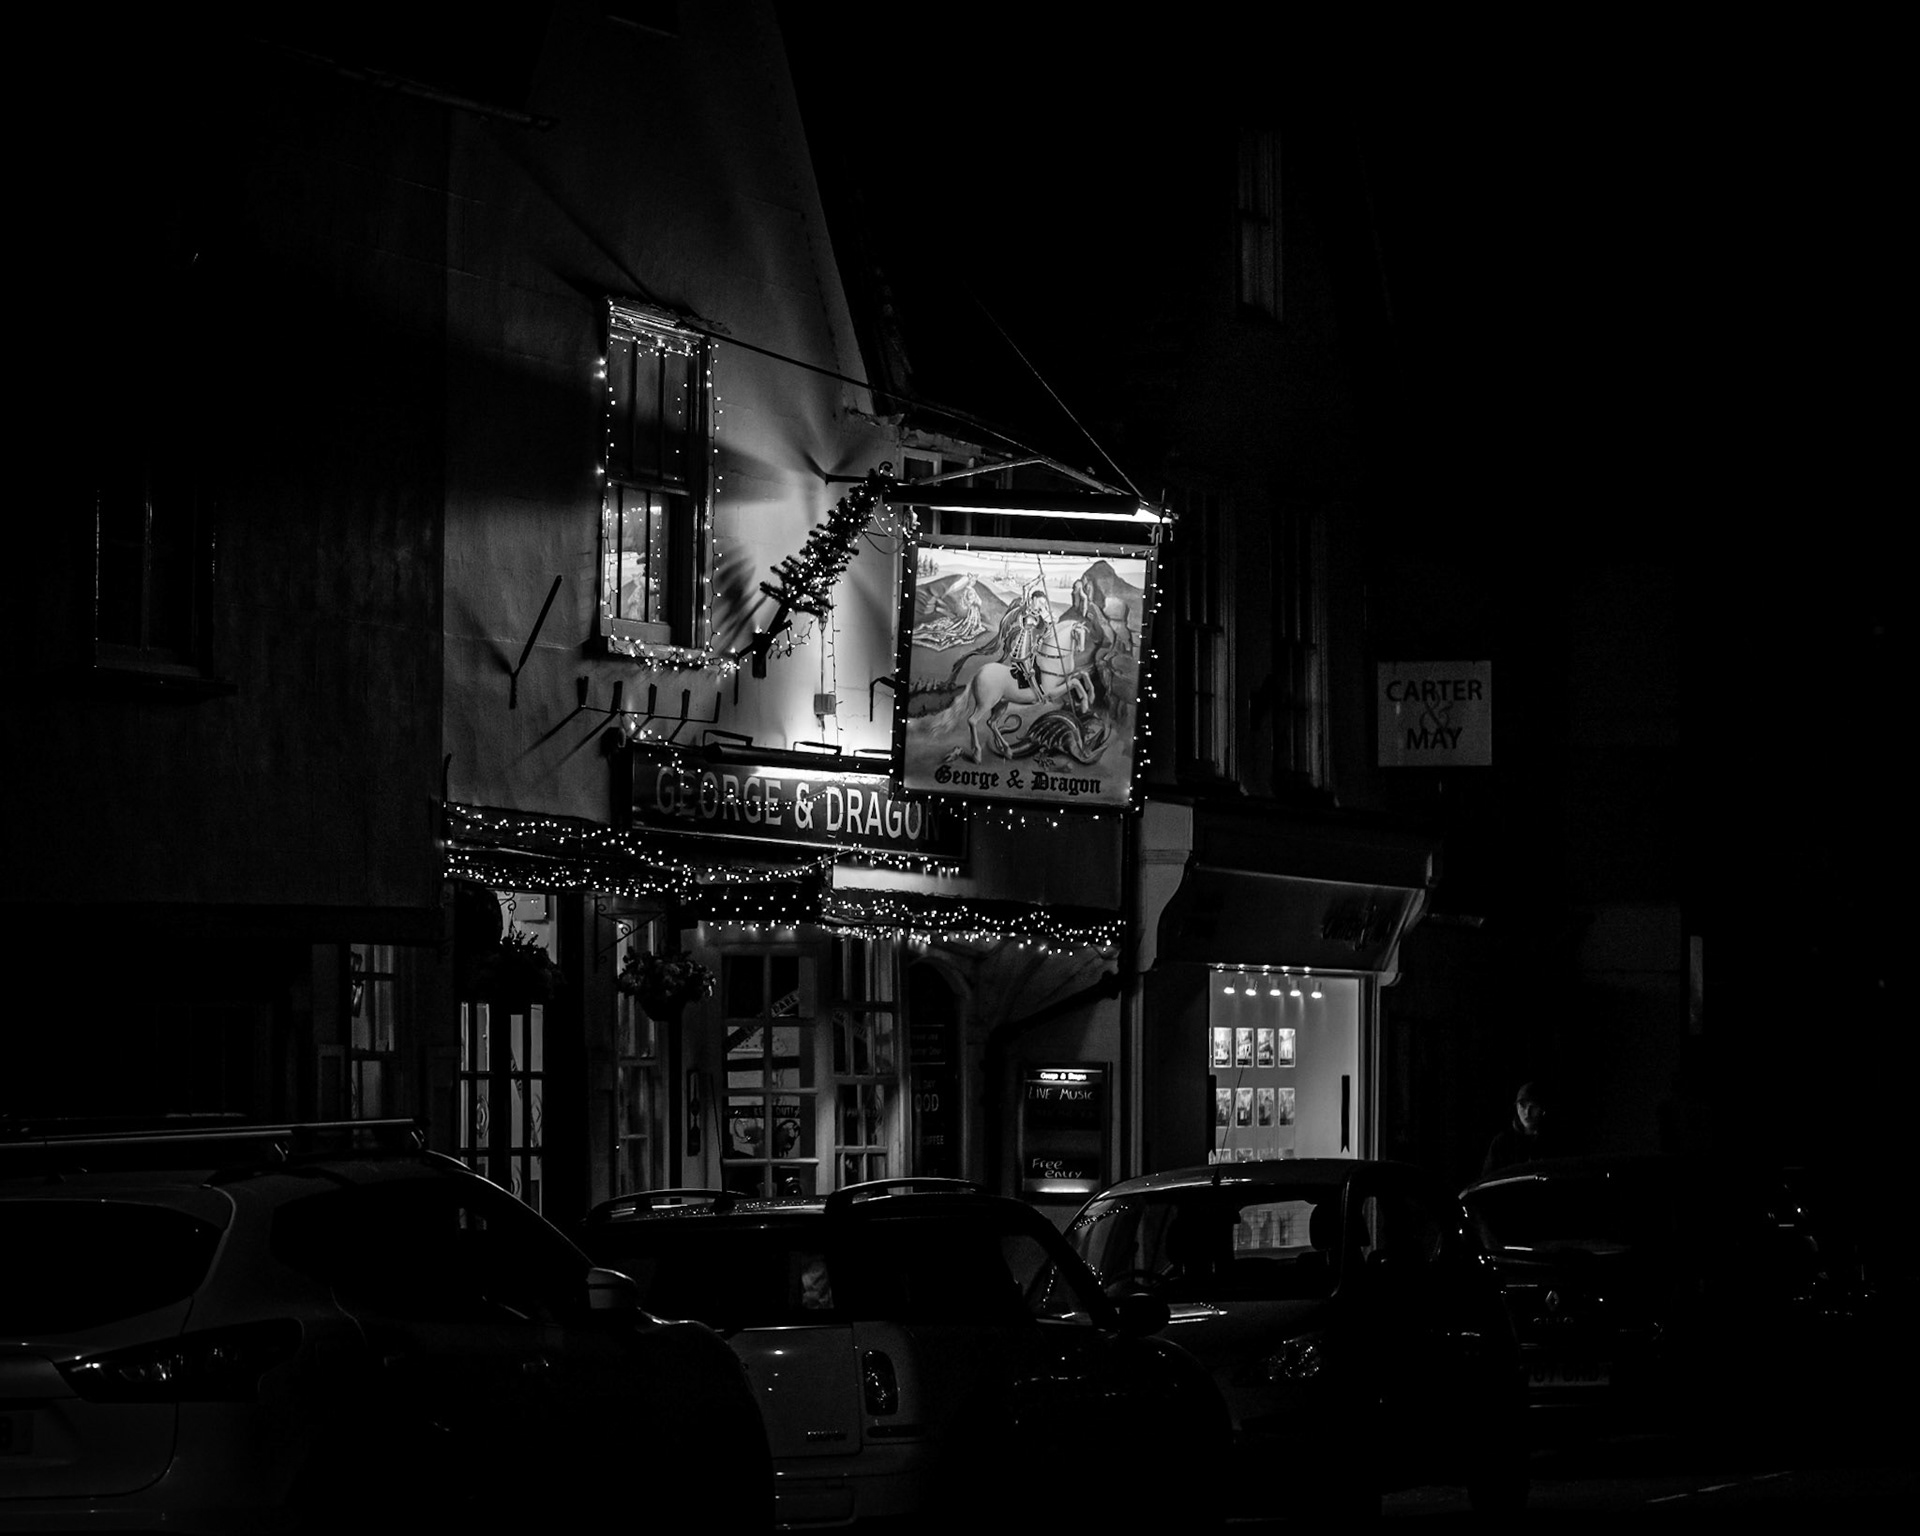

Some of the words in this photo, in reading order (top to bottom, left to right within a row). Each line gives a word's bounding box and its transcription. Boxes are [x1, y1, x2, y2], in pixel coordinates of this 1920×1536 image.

[1386, 680, 1482, 702] CARTER
[1419, 690, 1454, 736] &
[1406, 727, 1463, 750] MAY
[934, 764, 1000, 790] George
[1006, 769, 1024, 789] &
[1031, 770, 1102, 796] Dragon
[655, 765, 783, 826] GEORGE
[794, 780, 814, 830] &
[1028, 1086, 1053, 1101] LIVE
[1059, 1087, 1095, 1102] MUSIC
[1032, 1157, 1063, 1170] Free
[1044, 1169, 1082, 1179] entry
